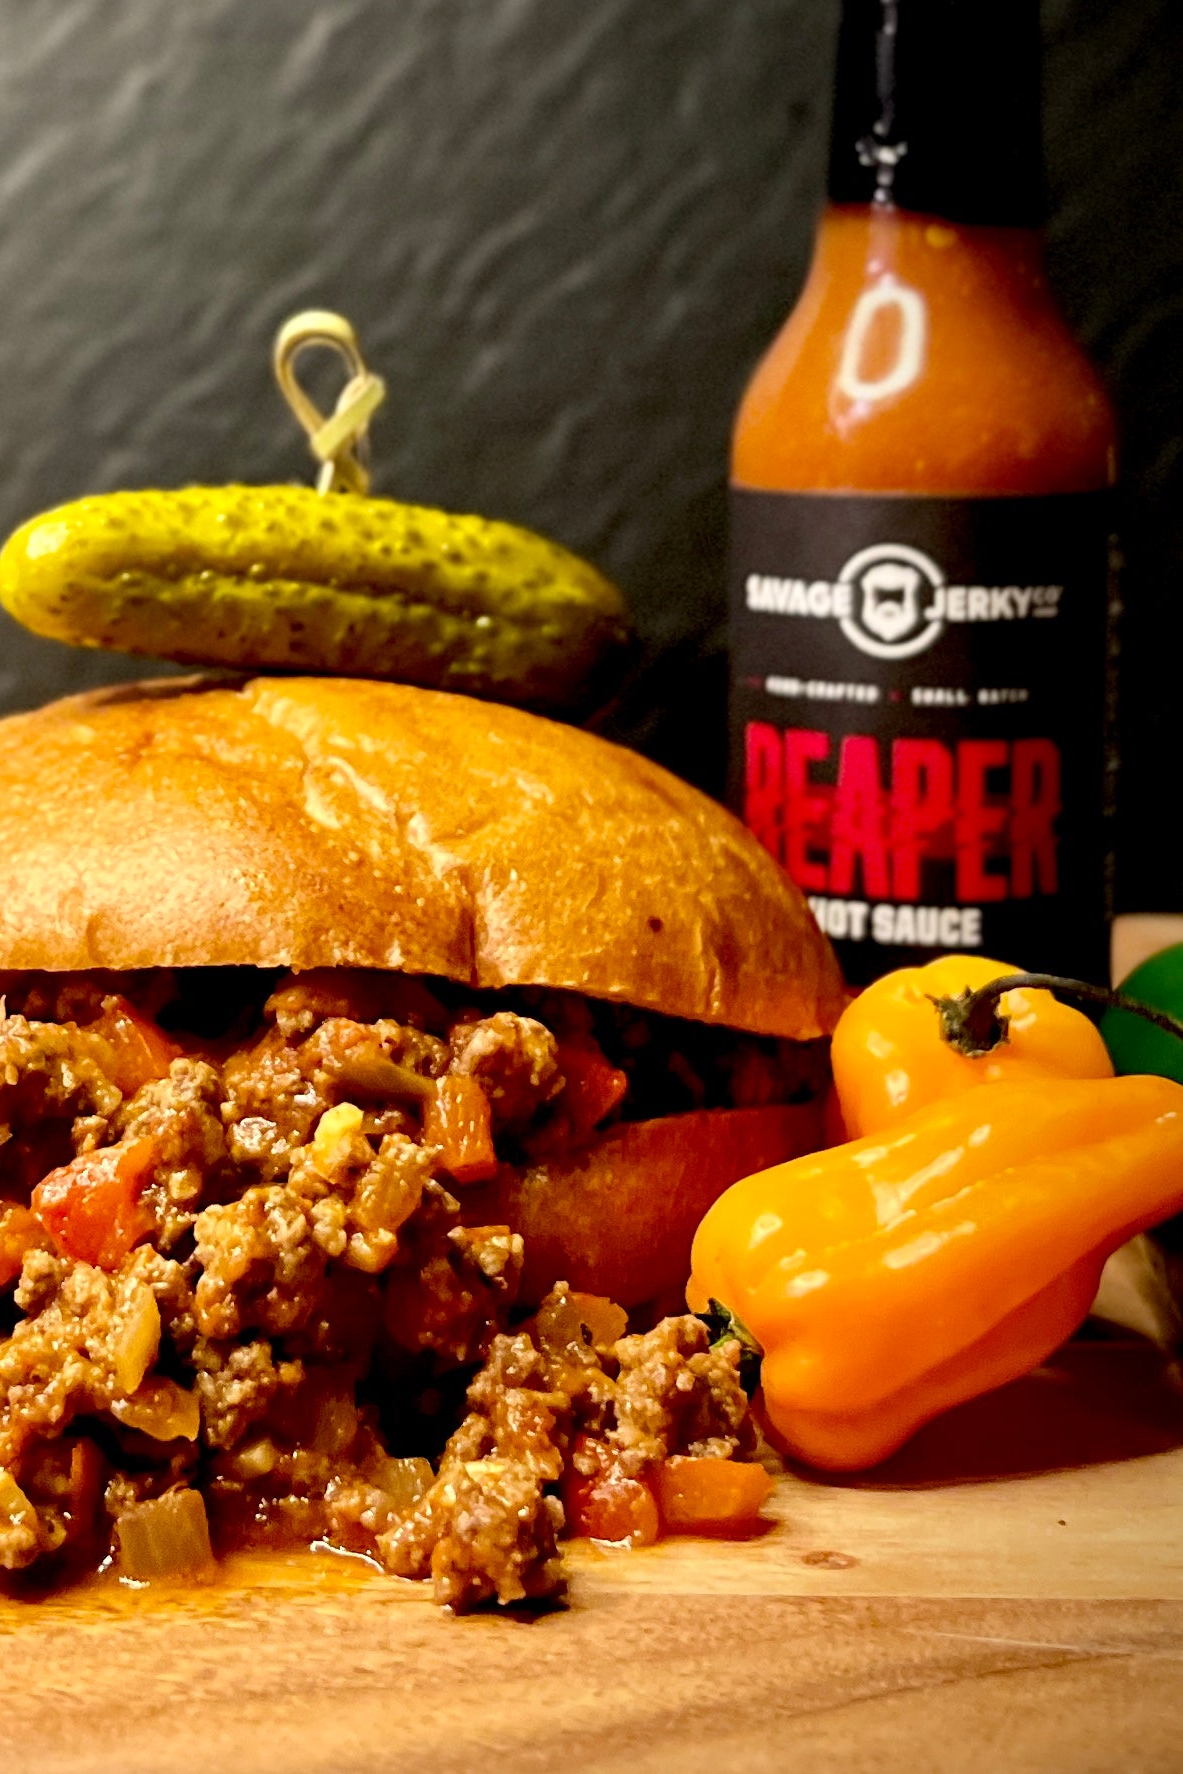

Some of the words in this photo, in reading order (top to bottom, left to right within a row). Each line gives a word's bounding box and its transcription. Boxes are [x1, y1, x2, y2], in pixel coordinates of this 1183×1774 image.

[746, 573, 852, 618] SAVAGE
[924, 585, 1033, 621] JERKY
[746, 722, 1059, 900] REAPER
[872, 903, 982, 948] SAUCE
